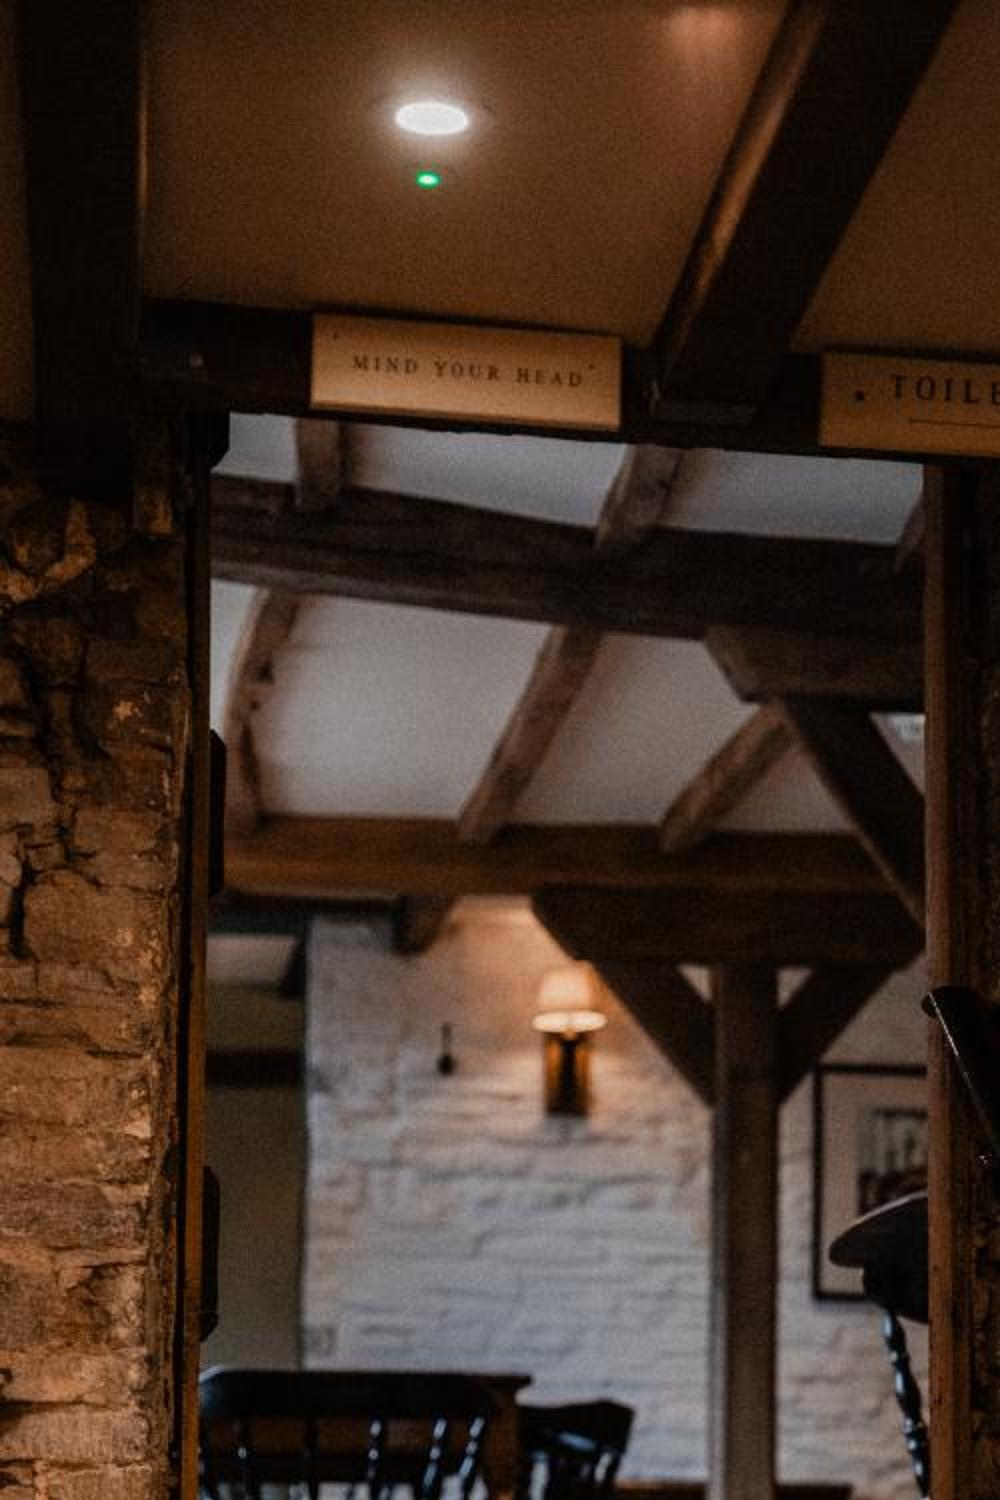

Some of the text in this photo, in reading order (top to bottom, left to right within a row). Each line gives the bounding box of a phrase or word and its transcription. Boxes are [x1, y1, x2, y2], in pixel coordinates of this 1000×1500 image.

[353, 354, 583, 388] MIND YOUR HEAD
